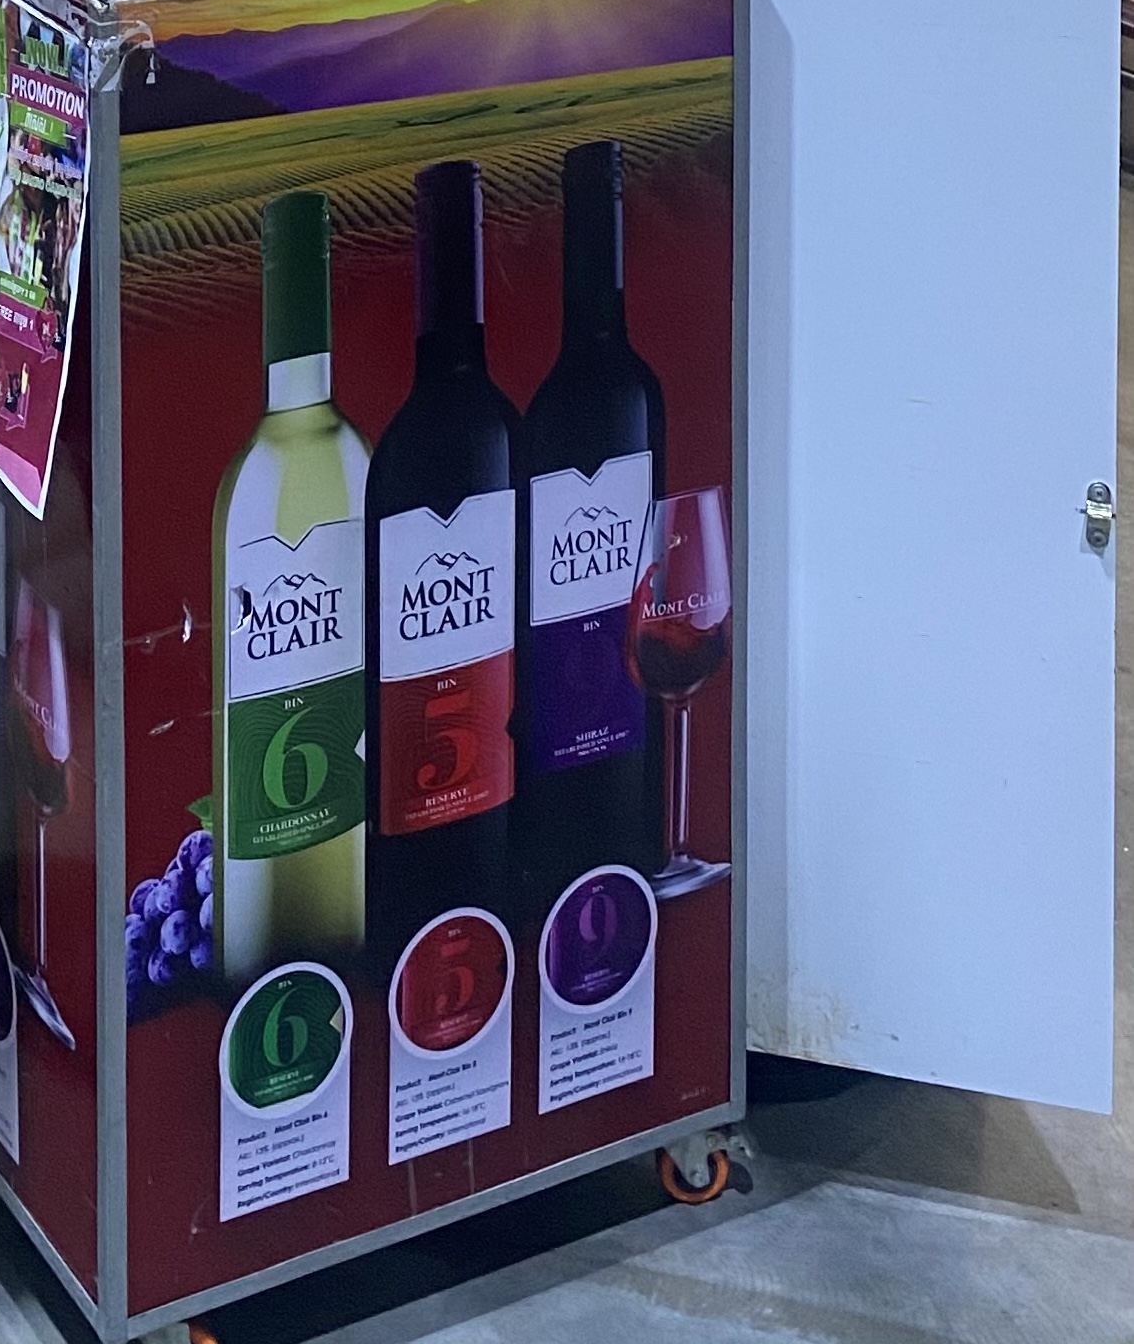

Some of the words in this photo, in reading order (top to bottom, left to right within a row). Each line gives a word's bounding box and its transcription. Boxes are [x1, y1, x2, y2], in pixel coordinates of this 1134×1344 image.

[11, 73, 85, 119] PROMOTION
[551, 519, 632, 561] MONT
[550, 546, 633, 586] CLAIR
[248, 588, 343, 634] MONT
[400, 566, 495, 614] MONT
[641, 599, 683, 620] MONT
[247, 616, 343, 660] CLAIR
[399, 596, 495, 641] CLAIR
[583, 620, 601, 632] BIN
[284, 696, 305, 710] BIN
[437, 678, 457, 691] BIN
[417, 691, 477, 790] 5
[575, 725, 610, 743] SHIRAZ
[262, 706, 328, 809] 6
[425, 787, 469, 808] RESERVE
[259, 807, 330, 834] CHARDONNAY
[579, 894, 618, 958] 9
[262, 987, 308, 1067] 6
